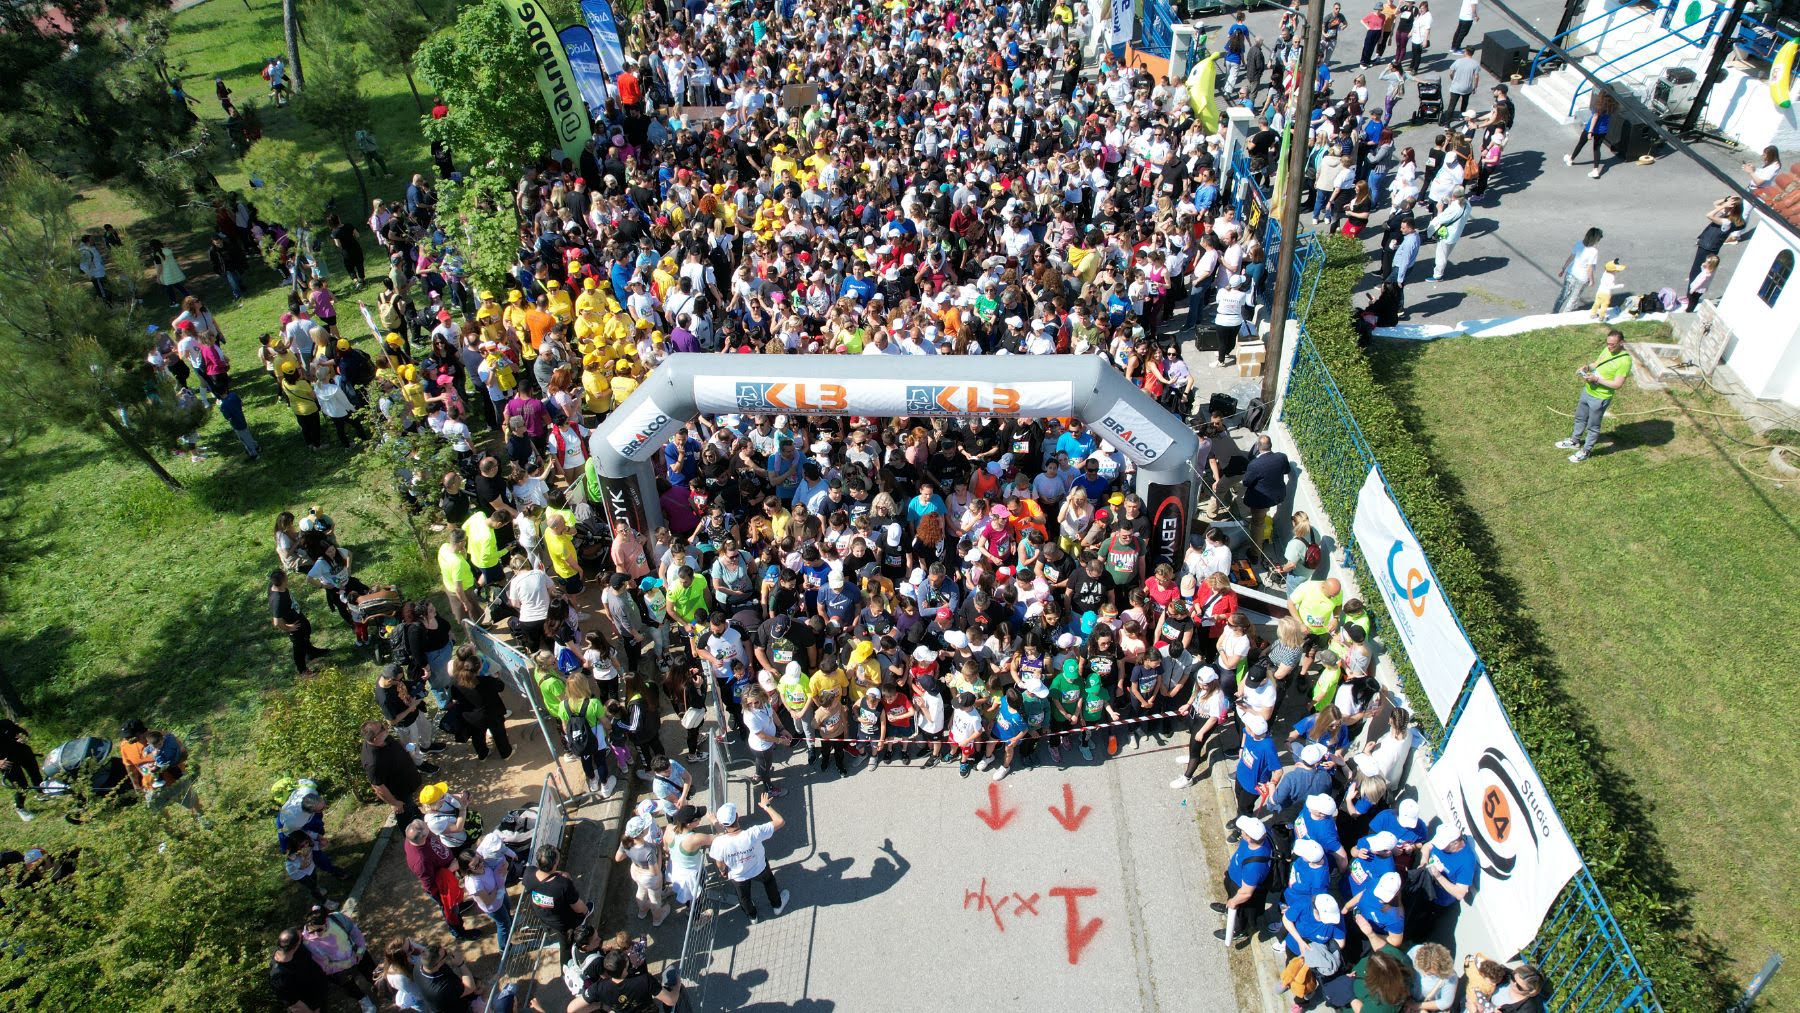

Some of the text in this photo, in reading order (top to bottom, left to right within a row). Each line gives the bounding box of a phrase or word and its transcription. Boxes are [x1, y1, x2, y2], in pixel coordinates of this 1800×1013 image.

[622, 414, 668, 457] BRALCO
[1102, 416, 1157, 459] BRALCO
[1484, 789, 1510, 840] 54
[1521, 780, 1550, 838] Studio
